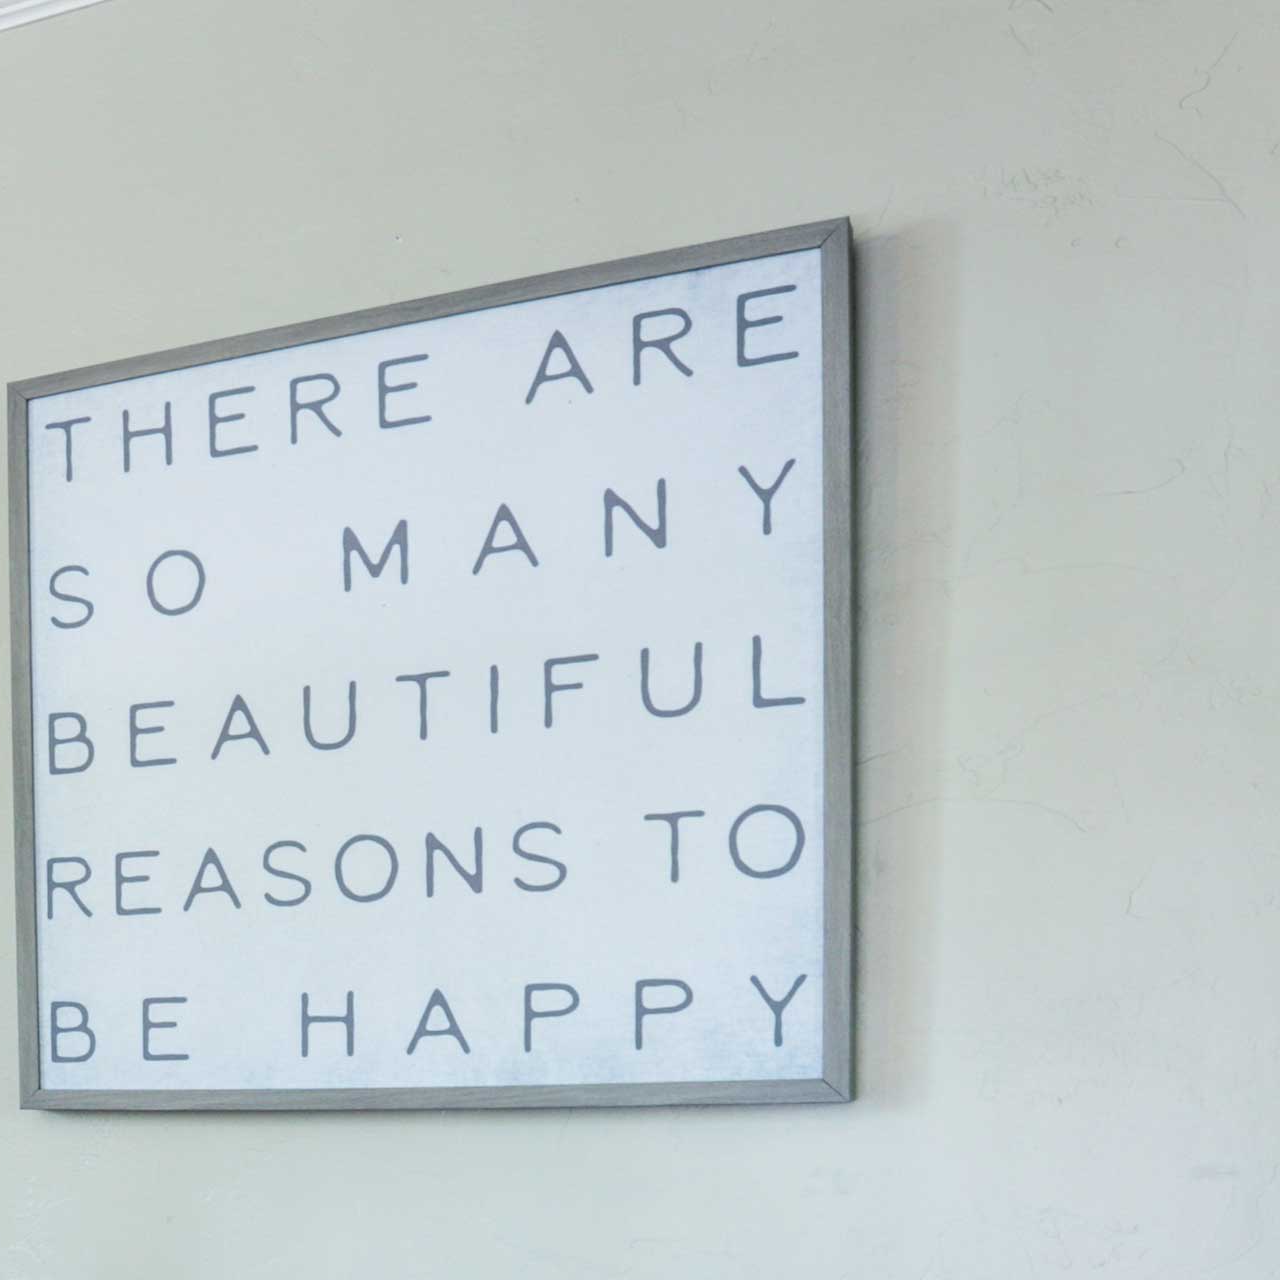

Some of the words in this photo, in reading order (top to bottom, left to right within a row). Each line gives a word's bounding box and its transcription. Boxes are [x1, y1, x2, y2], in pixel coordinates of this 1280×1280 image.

[45, 354, 433, 483] THERE
[525, 284, 800, 405] ARE
[48, 550, 206, 629] SO
[343, 459, 796, 592] MANY
[48, 635, 807, 775] BEAUTIFUL
[46, 822, 568, 920] REASONS
[644, 804, 806, 883] TO
[50, 997, 190, 1063] BE
[302, 974, 808, 1057] HAPPY
